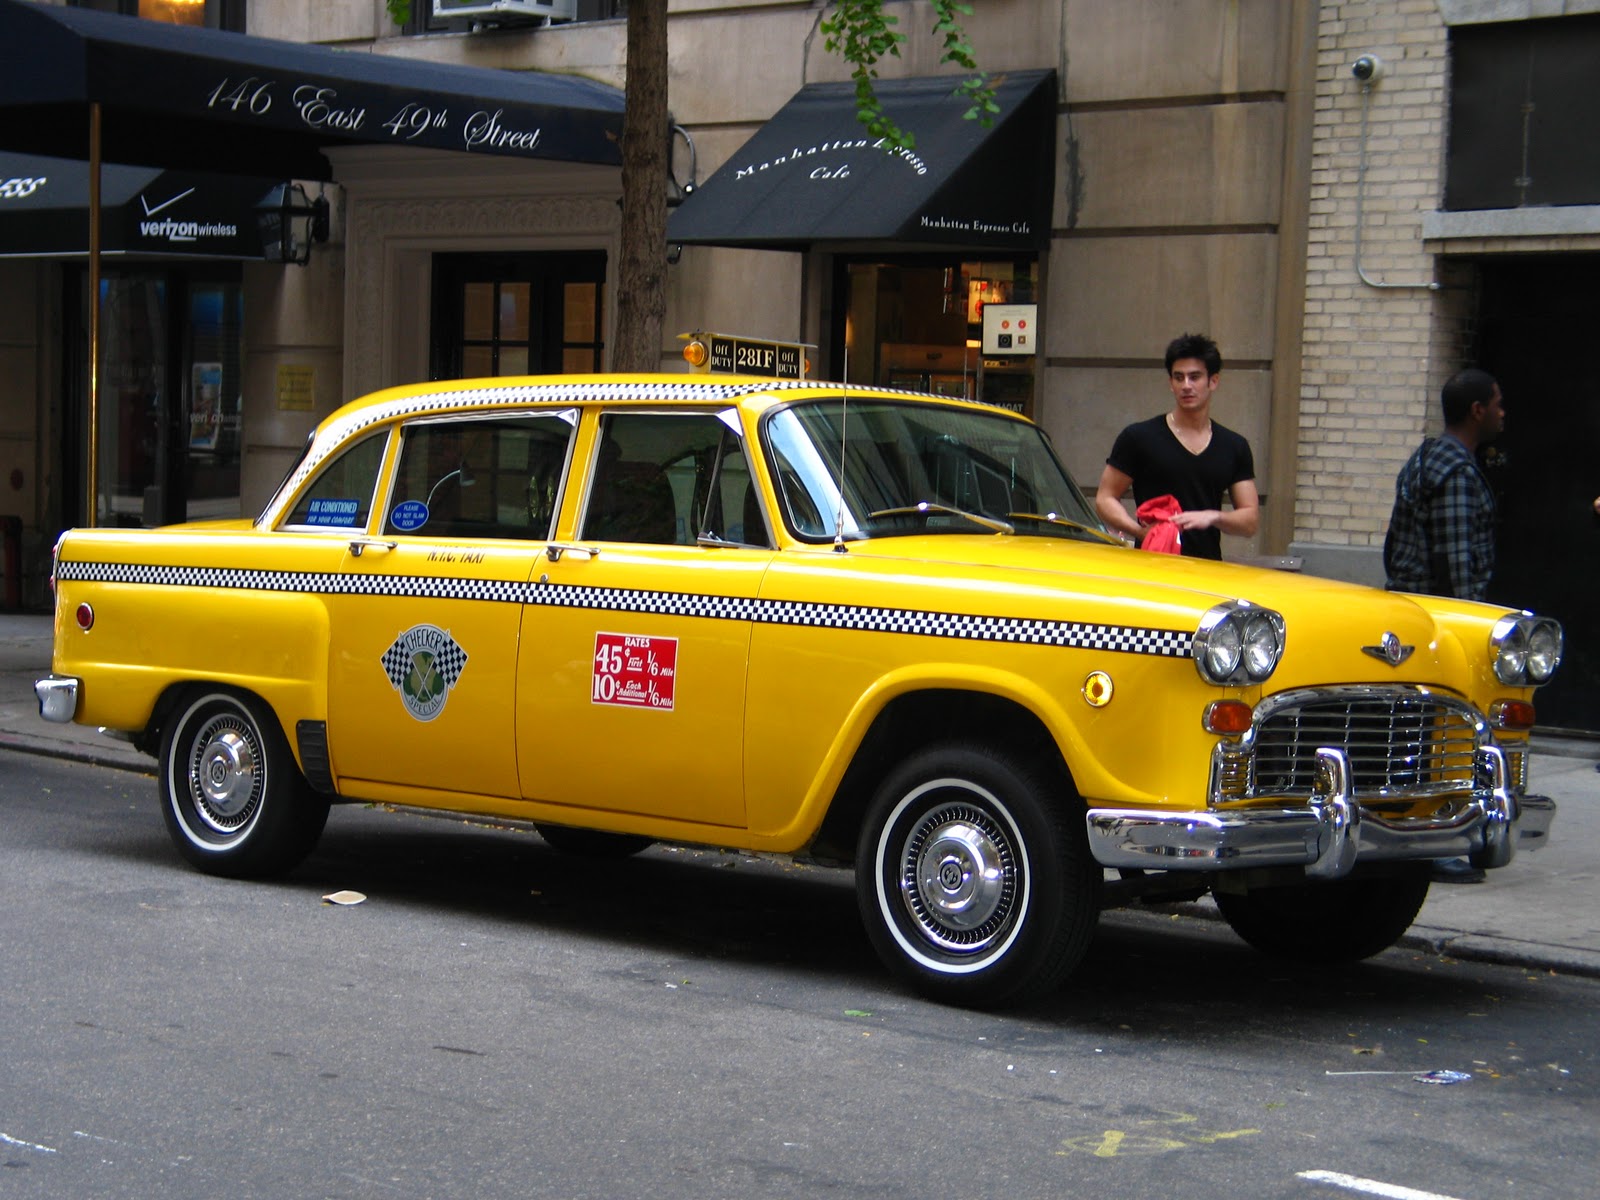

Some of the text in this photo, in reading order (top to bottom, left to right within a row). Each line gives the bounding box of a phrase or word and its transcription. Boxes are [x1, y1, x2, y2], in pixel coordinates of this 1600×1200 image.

[207, 77, 541, 151] 146 East 49th Street
[735, 136, 928, 180] Manhattan Epresso
[808, 164, 851, 179] Cafe
[920, 216, 1030, 233] Manhattan Espresso Cafe
[711, 355, 732, 368] DUTY
[778, 363, 799, 375] DUTY
[309, 501, 358, 514] AIR CONDITIONED
[306, 515, 355, 525] FOR YOUR COMFORT
[405, 628, 443, 651] CHECKER
[624, 637, 651, 648] RATES
[627, 656, 643, 668] First
[659, 667, 674, 677] Mile
[616, 688, 648, 698] Additional
[625, 680, 642, 690] Each
[658, 698, 673, 707] Mile
[408, 697, 441, 714] SPECIAL
